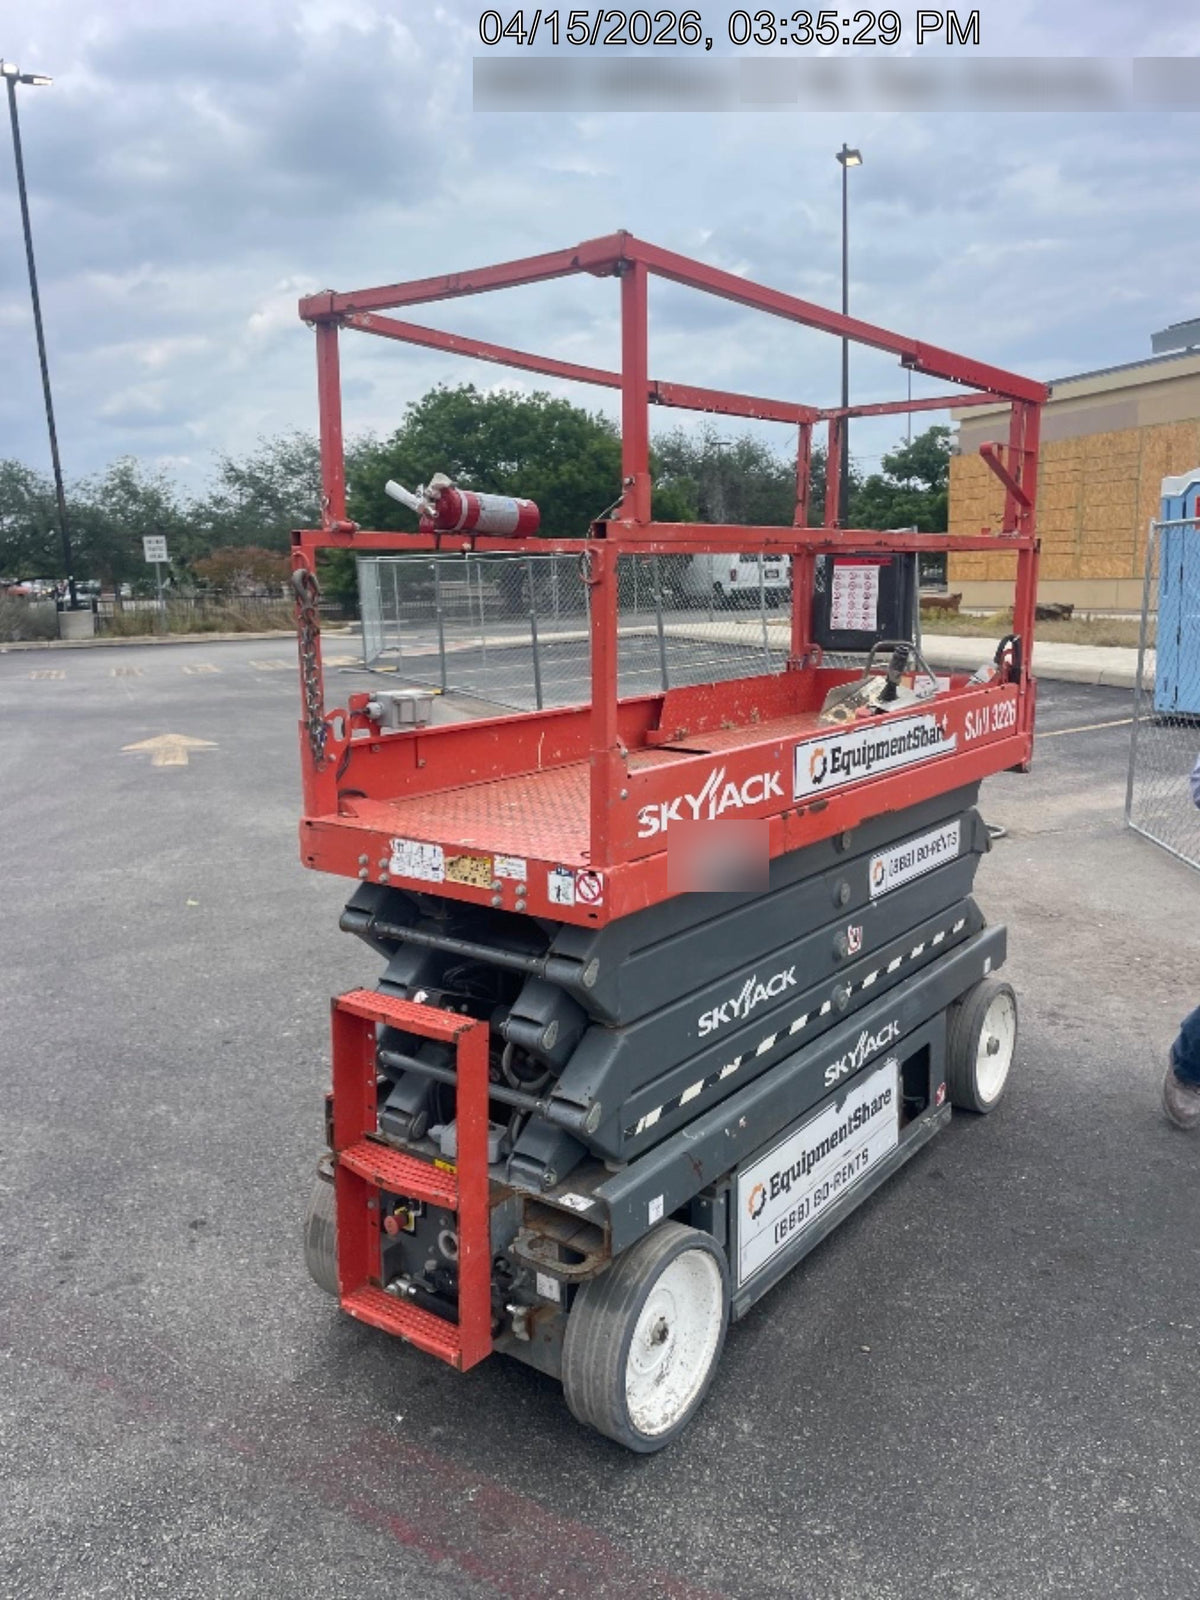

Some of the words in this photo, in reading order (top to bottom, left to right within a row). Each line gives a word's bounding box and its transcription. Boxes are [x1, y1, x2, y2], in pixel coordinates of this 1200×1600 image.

[829, 722, 948, 776] EquipmentShar
[991, 699, 1017, 732] 3226
[637, 766, 784, 838] SKYJACK
[697, 966, 798, 1037] SKYJACK
[824, 1020, 901, 1088] SKYJACK
[769, 1088, 892, 1201] EquipmentShare
